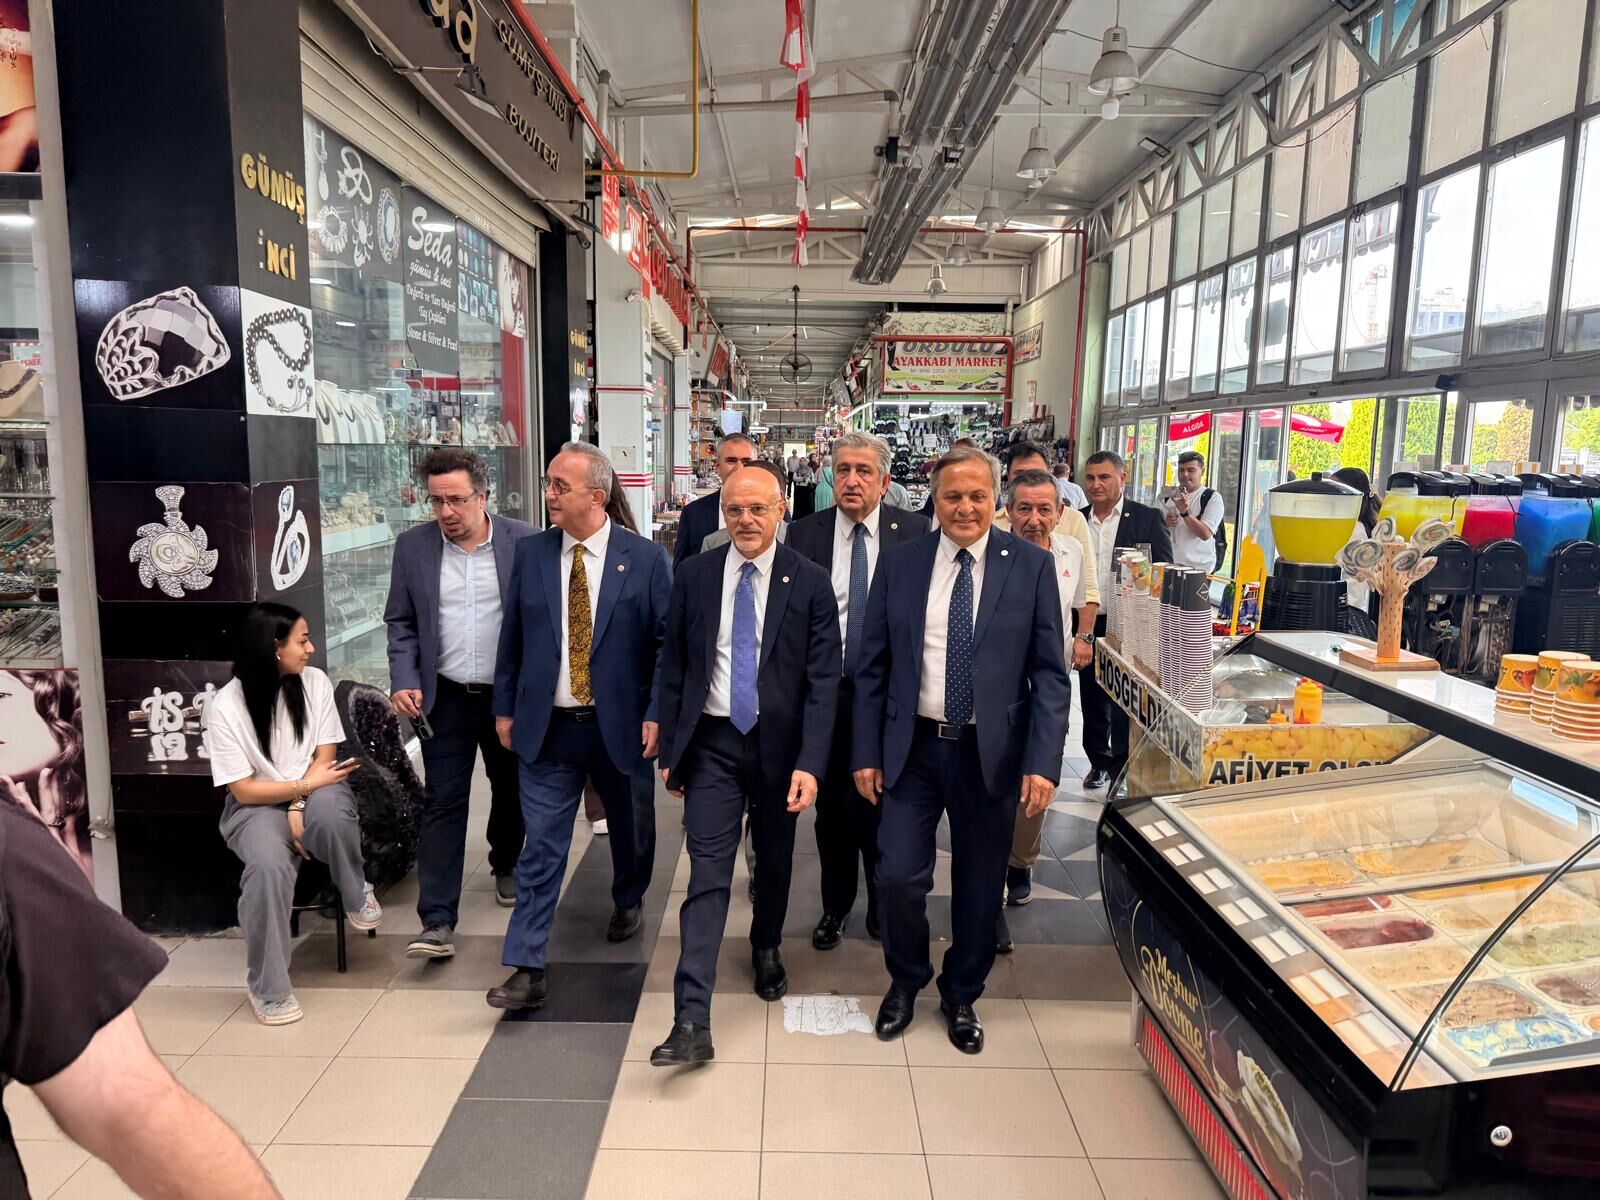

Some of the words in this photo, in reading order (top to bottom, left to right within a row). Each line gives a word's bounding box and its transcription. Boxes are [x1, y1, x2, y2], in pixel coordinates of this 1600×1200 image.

[241, 152, 305, 225] GÜMÜŞ
[408, 206, 453, 268] Seda
[407, 325, 422, 340] Stone
[421, 330, 427, 342] &
[427, 331, 442, 347] Silver
[442, 335, 448, 348] &
[447, 336, 458, 351] Pearl
[893, 356, 952, 367] AYAKKABI
[955, 356, 1005, 367] MARKET
[1182, 422, 1205, 434] ALGIDA
